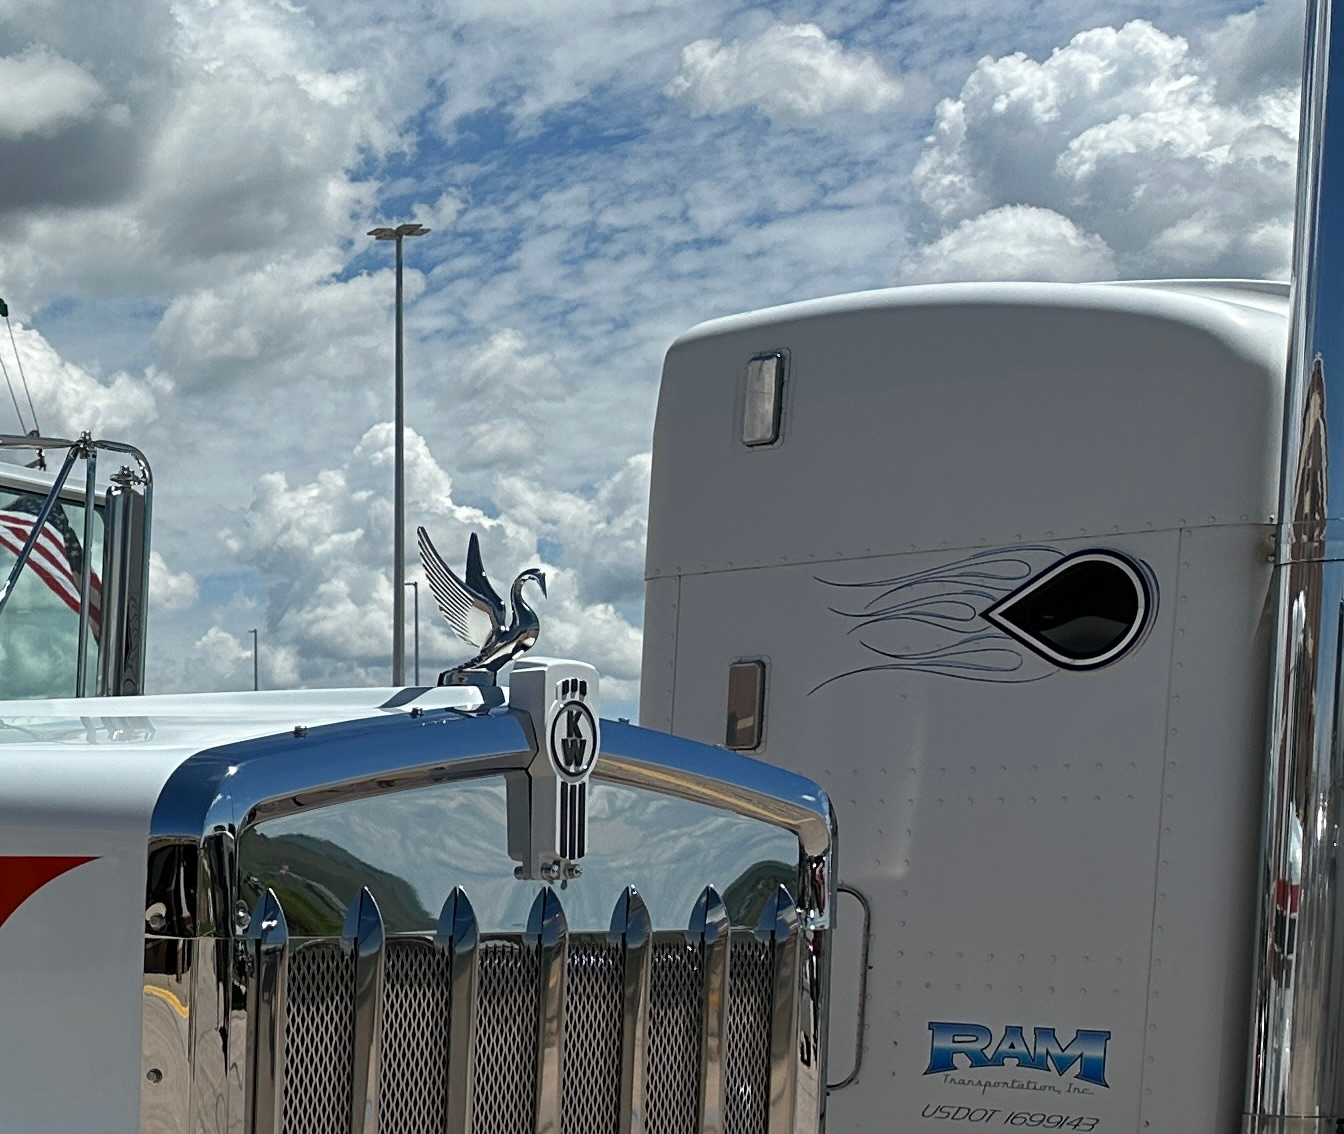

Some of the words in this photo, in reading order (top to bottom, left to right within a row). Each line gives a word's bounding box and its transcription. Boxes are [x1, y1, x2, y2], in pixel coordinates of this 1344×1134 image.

[922, 1021, 1111, 1088] RAM
[942, 1073, 1062, 1096] Transportation,
[1065, 1082, 1096, 1095] Inc.
[921, 1103, 1002, 1124] USDOT
[1003, 1111, 1100, 1132] 1699143
